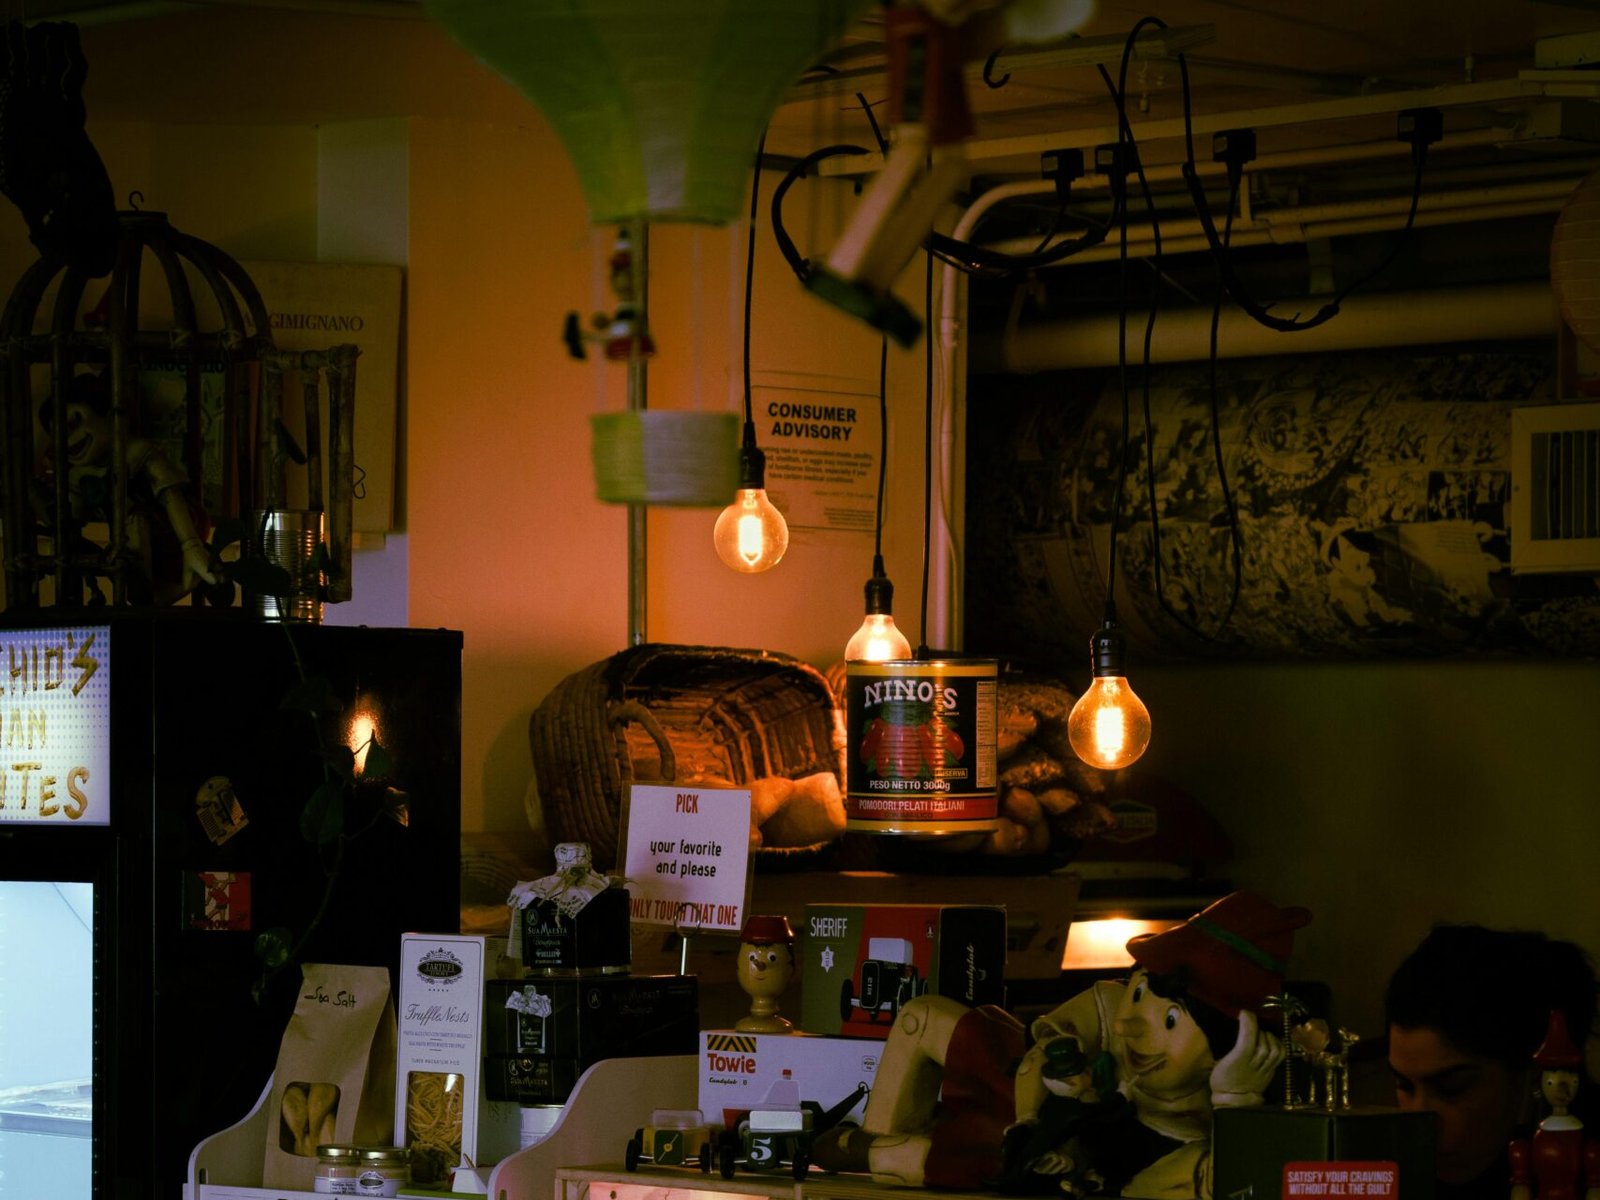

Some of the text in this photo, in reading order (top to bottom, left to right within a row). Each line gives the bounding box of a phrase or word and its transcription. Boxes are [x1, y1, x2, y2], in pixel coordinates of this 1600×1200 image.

[268, 312, 364, 332] GIMIGNANO
[768, 402, 857, 423] CONSUMER
[771, 421, 852, 441] ADVISORY
[0, 631, 99, 697] HIO'S
[863, 679, 959, 710] NINO'S
[869, 780, 890, 790] PESO
[891, 780, 921, 790] NETTO
[676, 793, 699, 814] PICK
[858, 800, 965, 811] POMODORI PELATI ITALIANI
[650, 839, 722, 857] your favorite
[656, 860, 716, 878] and please
[717, 904, 738, 926] ONE
[810, 915, 848, 939] SHERIFF
[333, 991, 357, 1008] Salt
[707, 1053, 756, 1074] Towie
[750, 1136, 773, 1161] 5
[1287, 1170, 1394, 1183] SATISFY YOUR CRAVINGS
[1288, 1183, 1392, 1195] WITHOUT ALL THE GUILT
